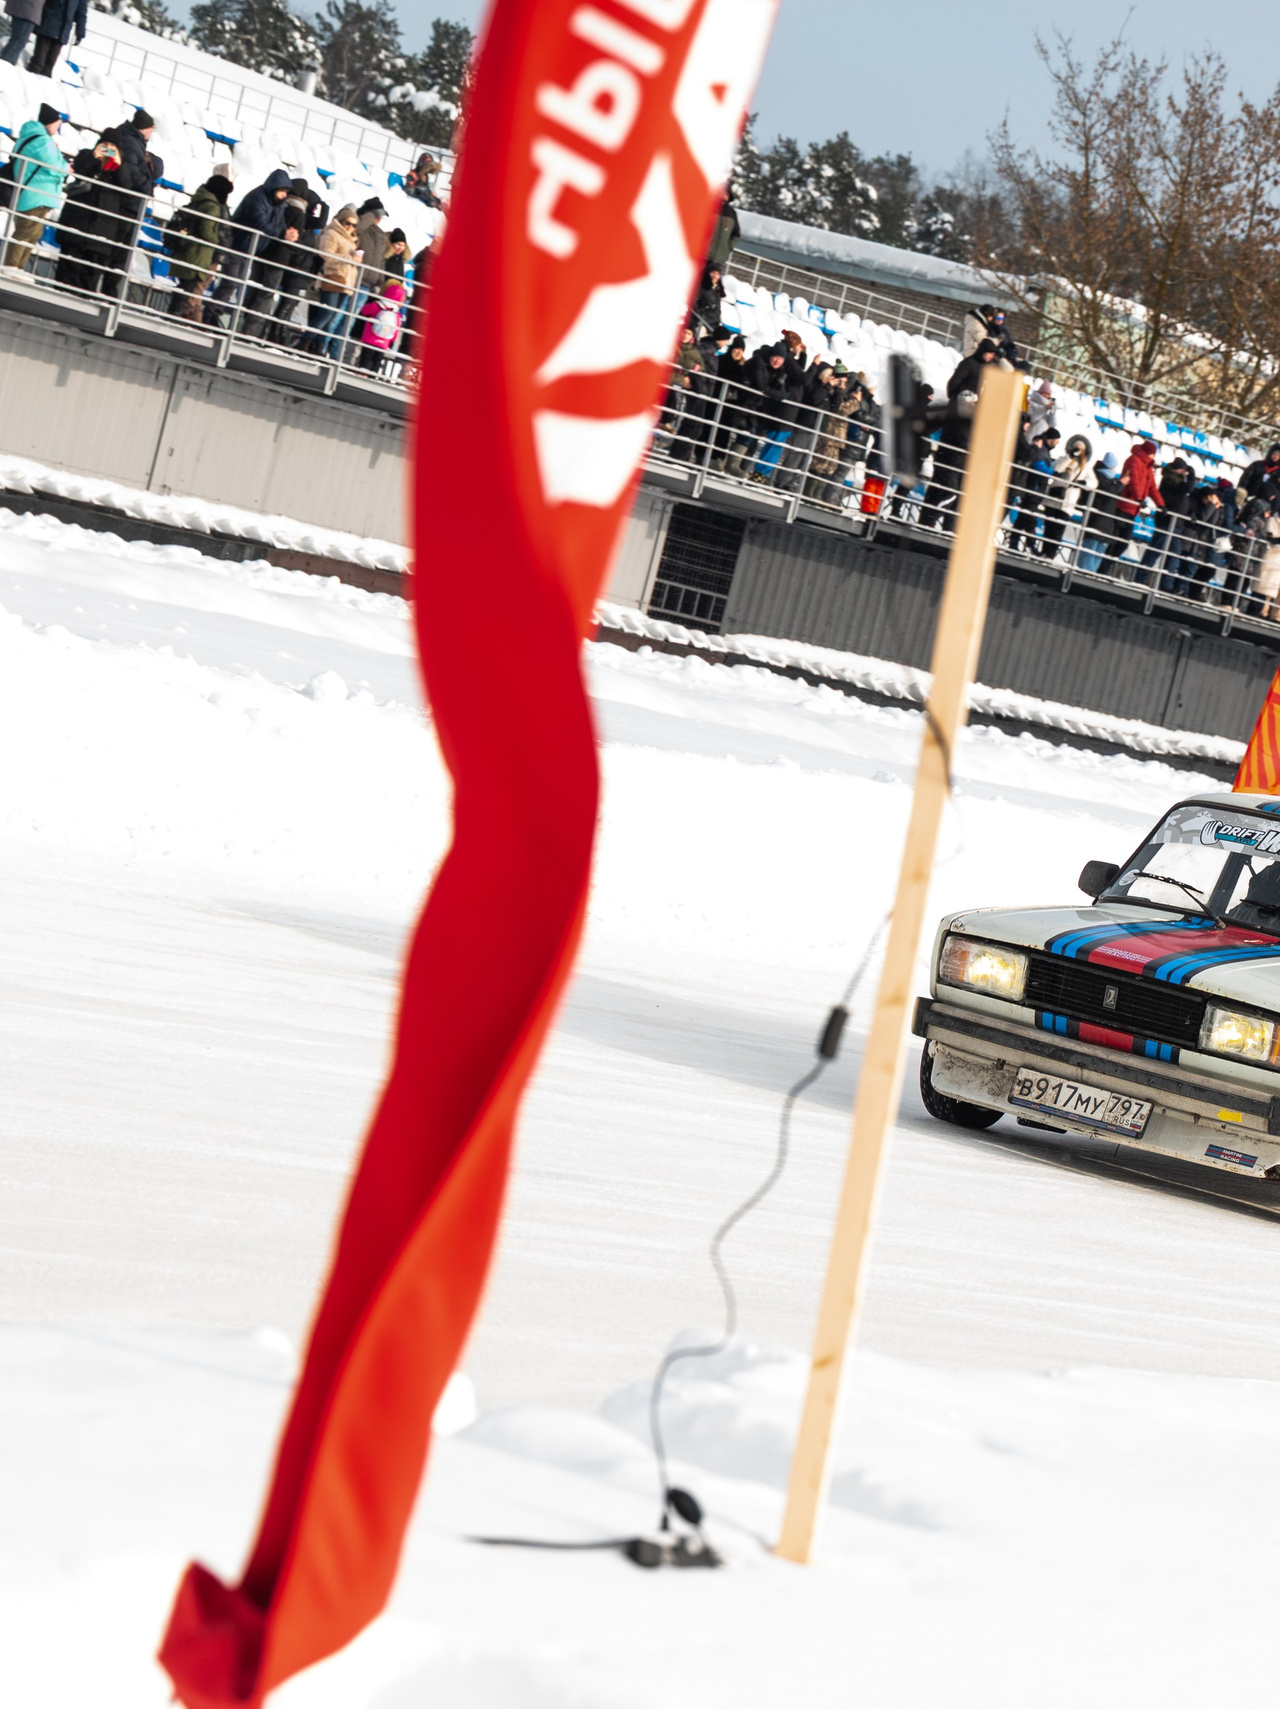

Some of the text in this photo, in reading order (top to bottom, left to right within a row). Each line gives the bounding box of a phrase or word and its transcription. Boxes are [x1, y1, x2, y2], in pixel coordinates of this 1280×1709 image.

[1218, 825, 1265, 841] DRIFT
[1108, 1095, 1145, 1120] 797
[1114, 1115, 1130, 1127] RUS
[1219, 1155, 1240, 1163] RACING
[1222, 1149, 1243, 1158] MARTINI
